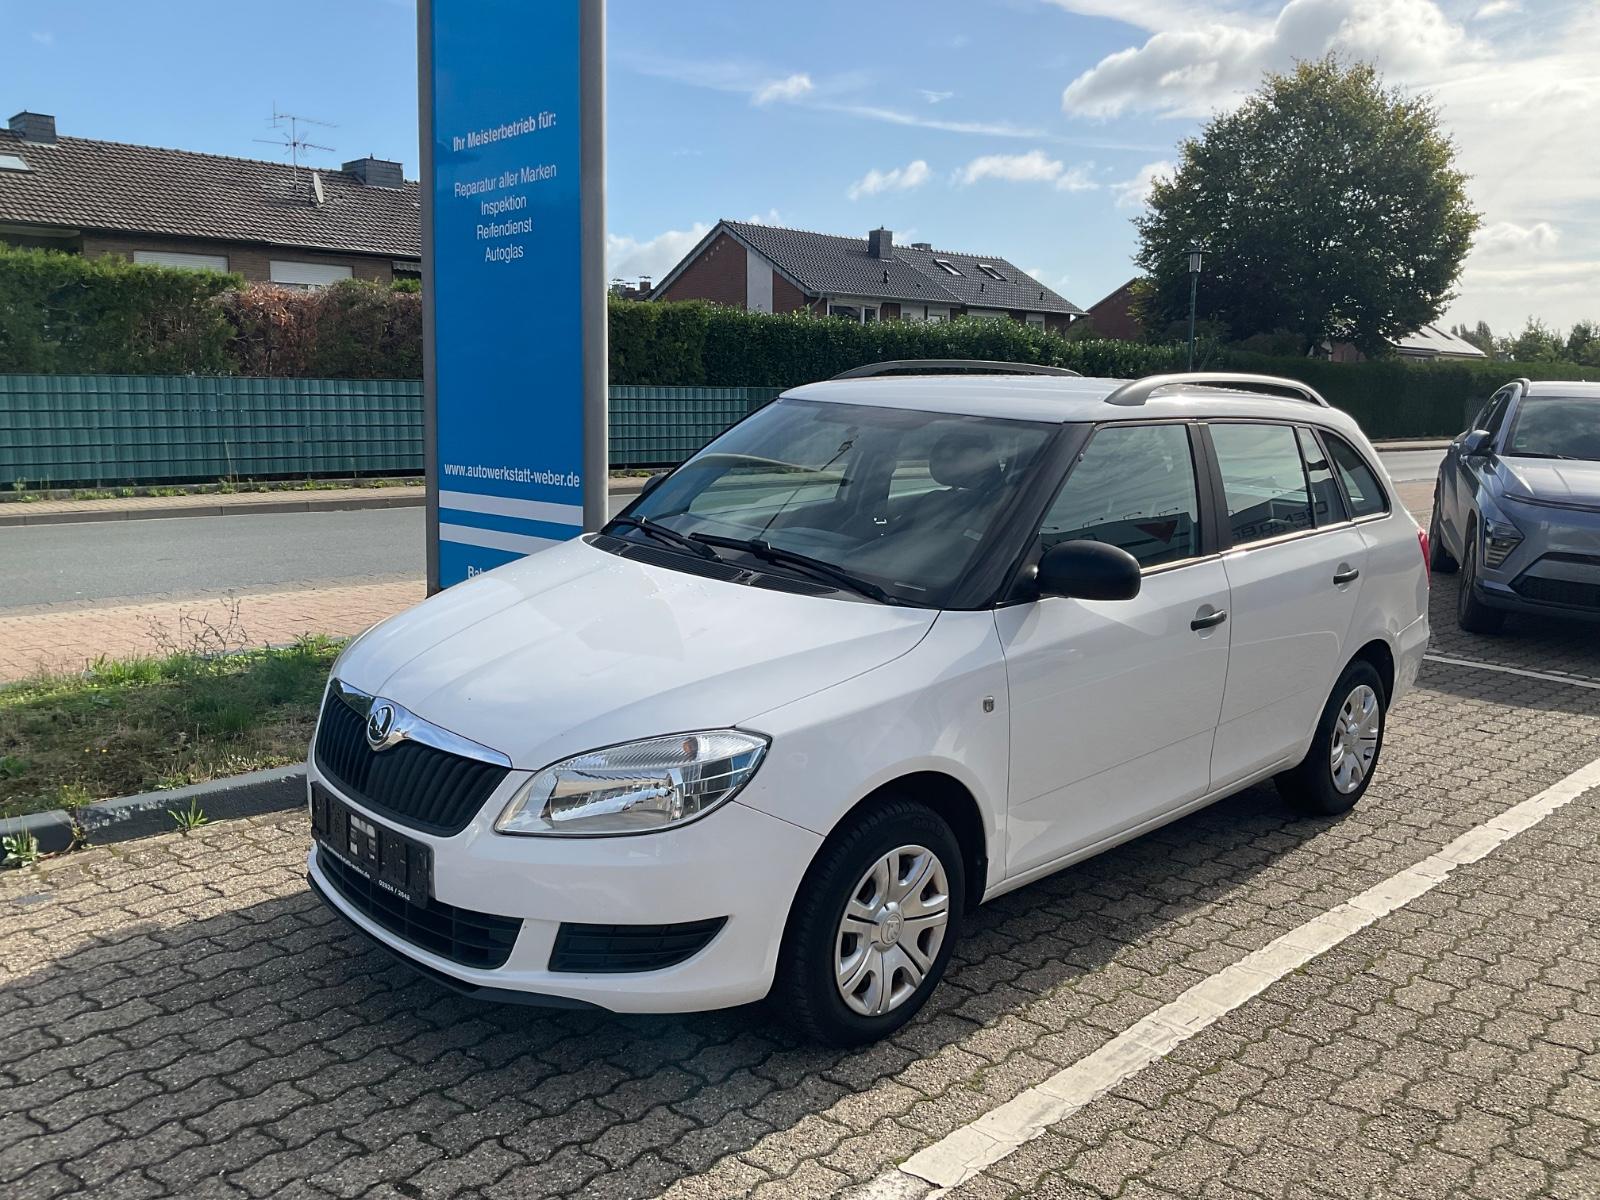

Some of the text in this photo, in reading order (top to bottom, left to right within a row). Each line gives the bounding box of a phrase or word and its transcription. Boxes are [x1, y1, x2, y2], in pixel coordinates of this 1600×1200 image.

[453, 111, 557, 152] Ihr Meisterbetrieb für:
[454, 164, 557, 198] Reparatur aller Marken
[481, 195, 527, 217] Inspektion
[476, 217, 533, 240] Reifendienst
[485, 243, 524, 264] Autoglas
[444, 463, 580, 488] www.autowerkstatt-weber.de
